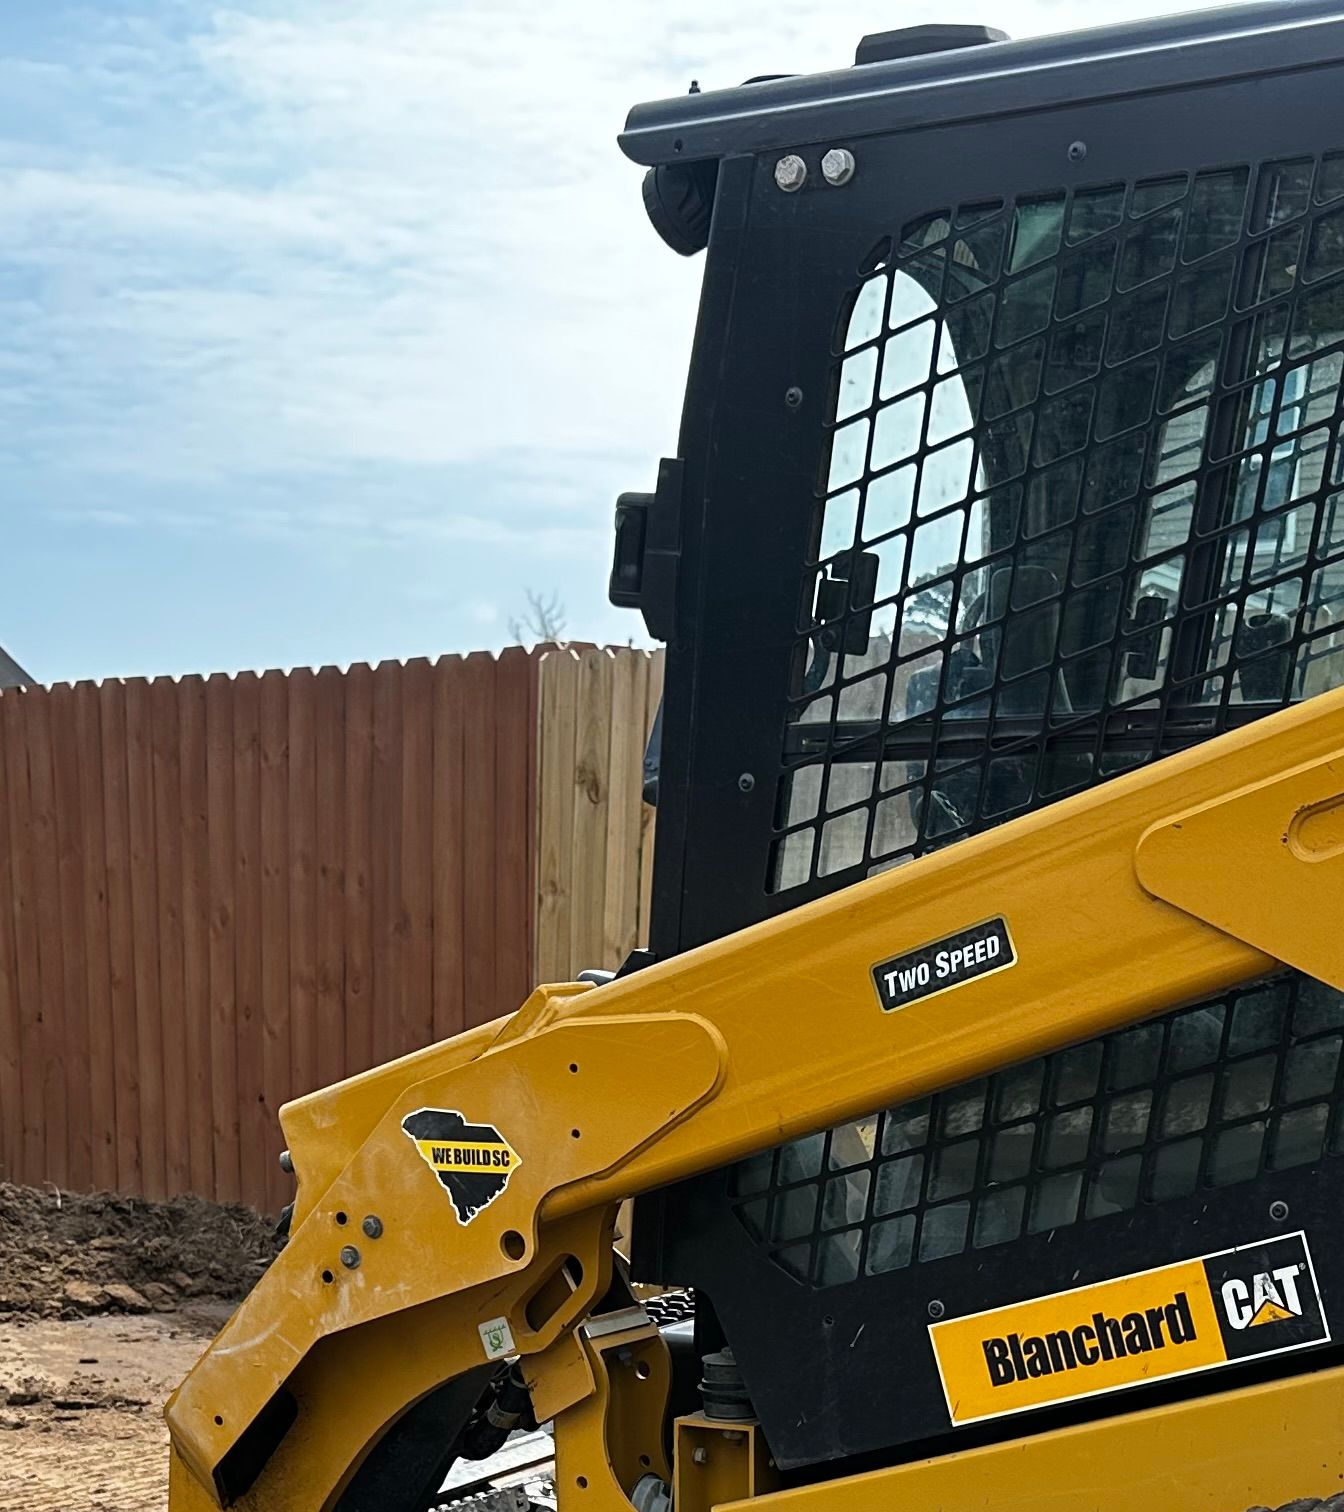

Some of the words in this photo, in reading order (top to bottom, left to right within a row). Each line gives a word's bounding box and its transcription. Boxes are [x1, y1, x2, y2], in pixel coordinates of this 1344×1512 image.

[431, 1147, 452, 1164] WE
[453, 1148, 491, 1166] BUILD
[492, 1150, 510, 1167] SC
[982, 1291, 1197, 1388] Blanchard
[1220, 1264, 1302, 1330] CAT
